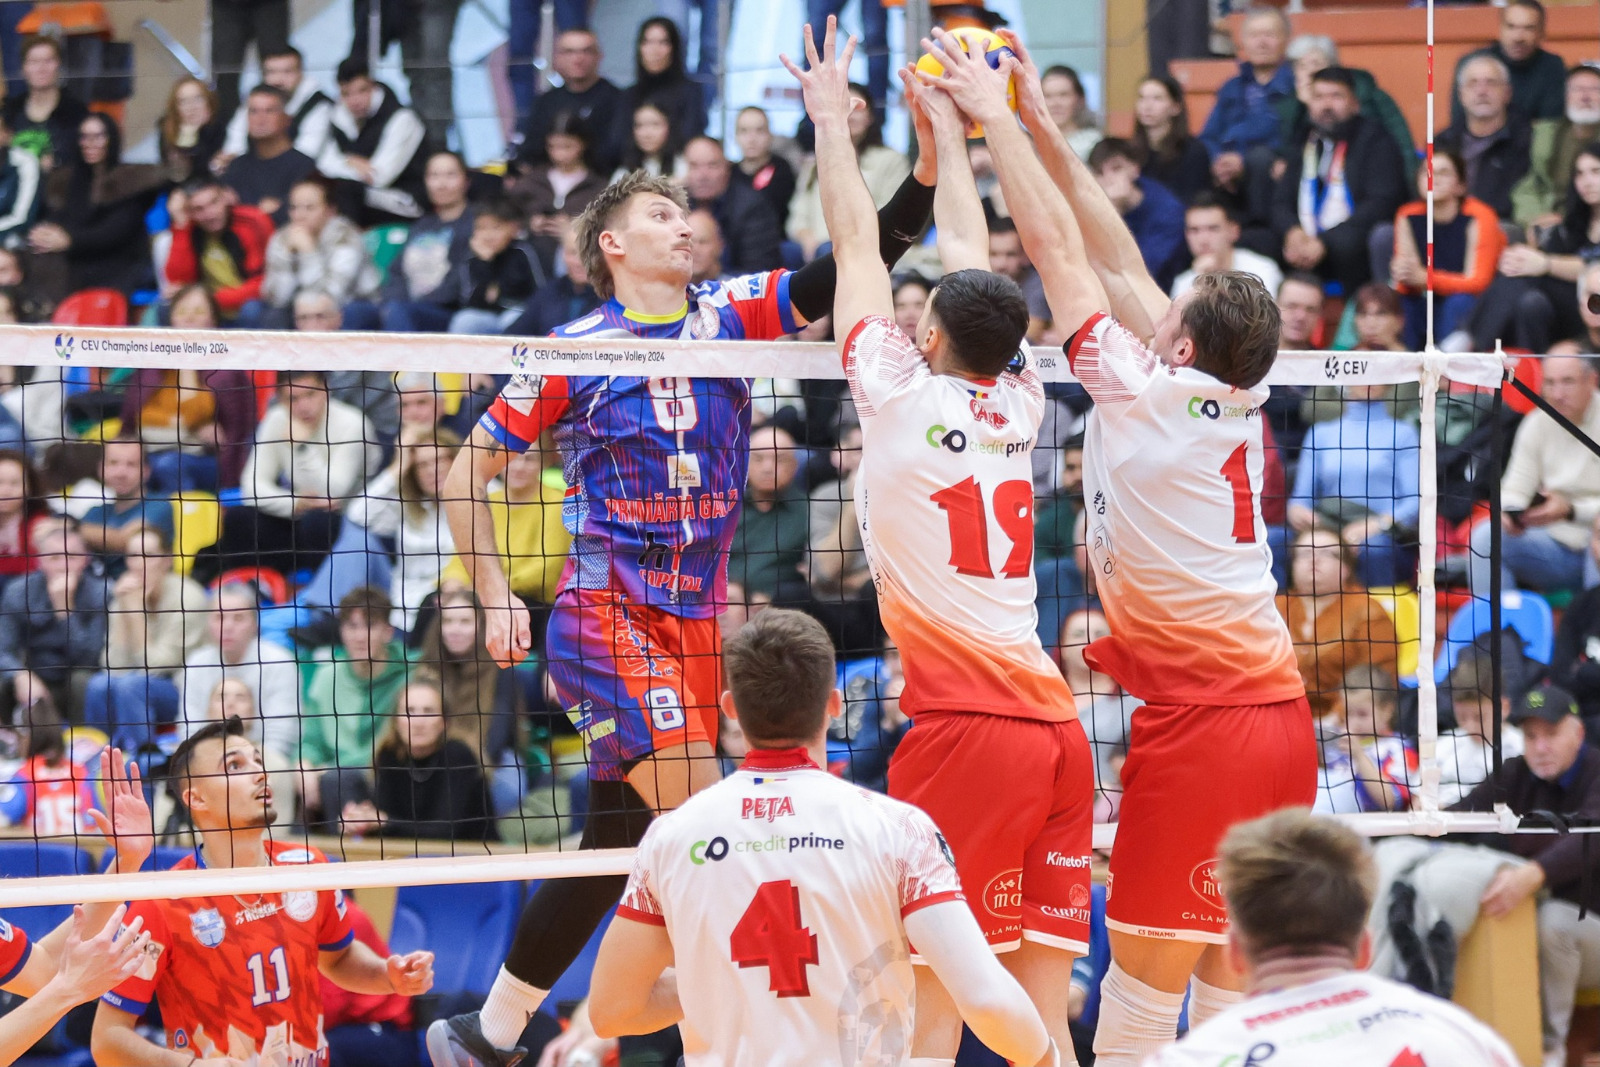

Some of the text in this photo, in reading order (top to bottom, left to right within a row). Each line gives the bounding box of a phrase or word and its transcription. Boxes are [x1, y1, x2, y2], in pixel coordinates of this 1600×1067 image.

[81, 339, 229, 356] CEV Champions League Volley 2024
[534, 349, 666, 365] CEV Champions League Volley 2024
[1039, 358, 1057, 369] 2024
[1343, 360, 1369, 375] CEV
[647, 377, 700, 433] 8
[604, 491, 696, 524] PRIMĂRIA
[1218, 440, 1257, 544] 1
[929, 474, 1035, 580] 19
[643, 686, 686, 732] 8
[1181, 912, 1197, 920] CA
[1200, 914, 1213, 922] LA
[730, 879, 820, 999] 4
[1147, 930, 1176, 938] DINAMO
[246, 945, 291, 1007] 11
